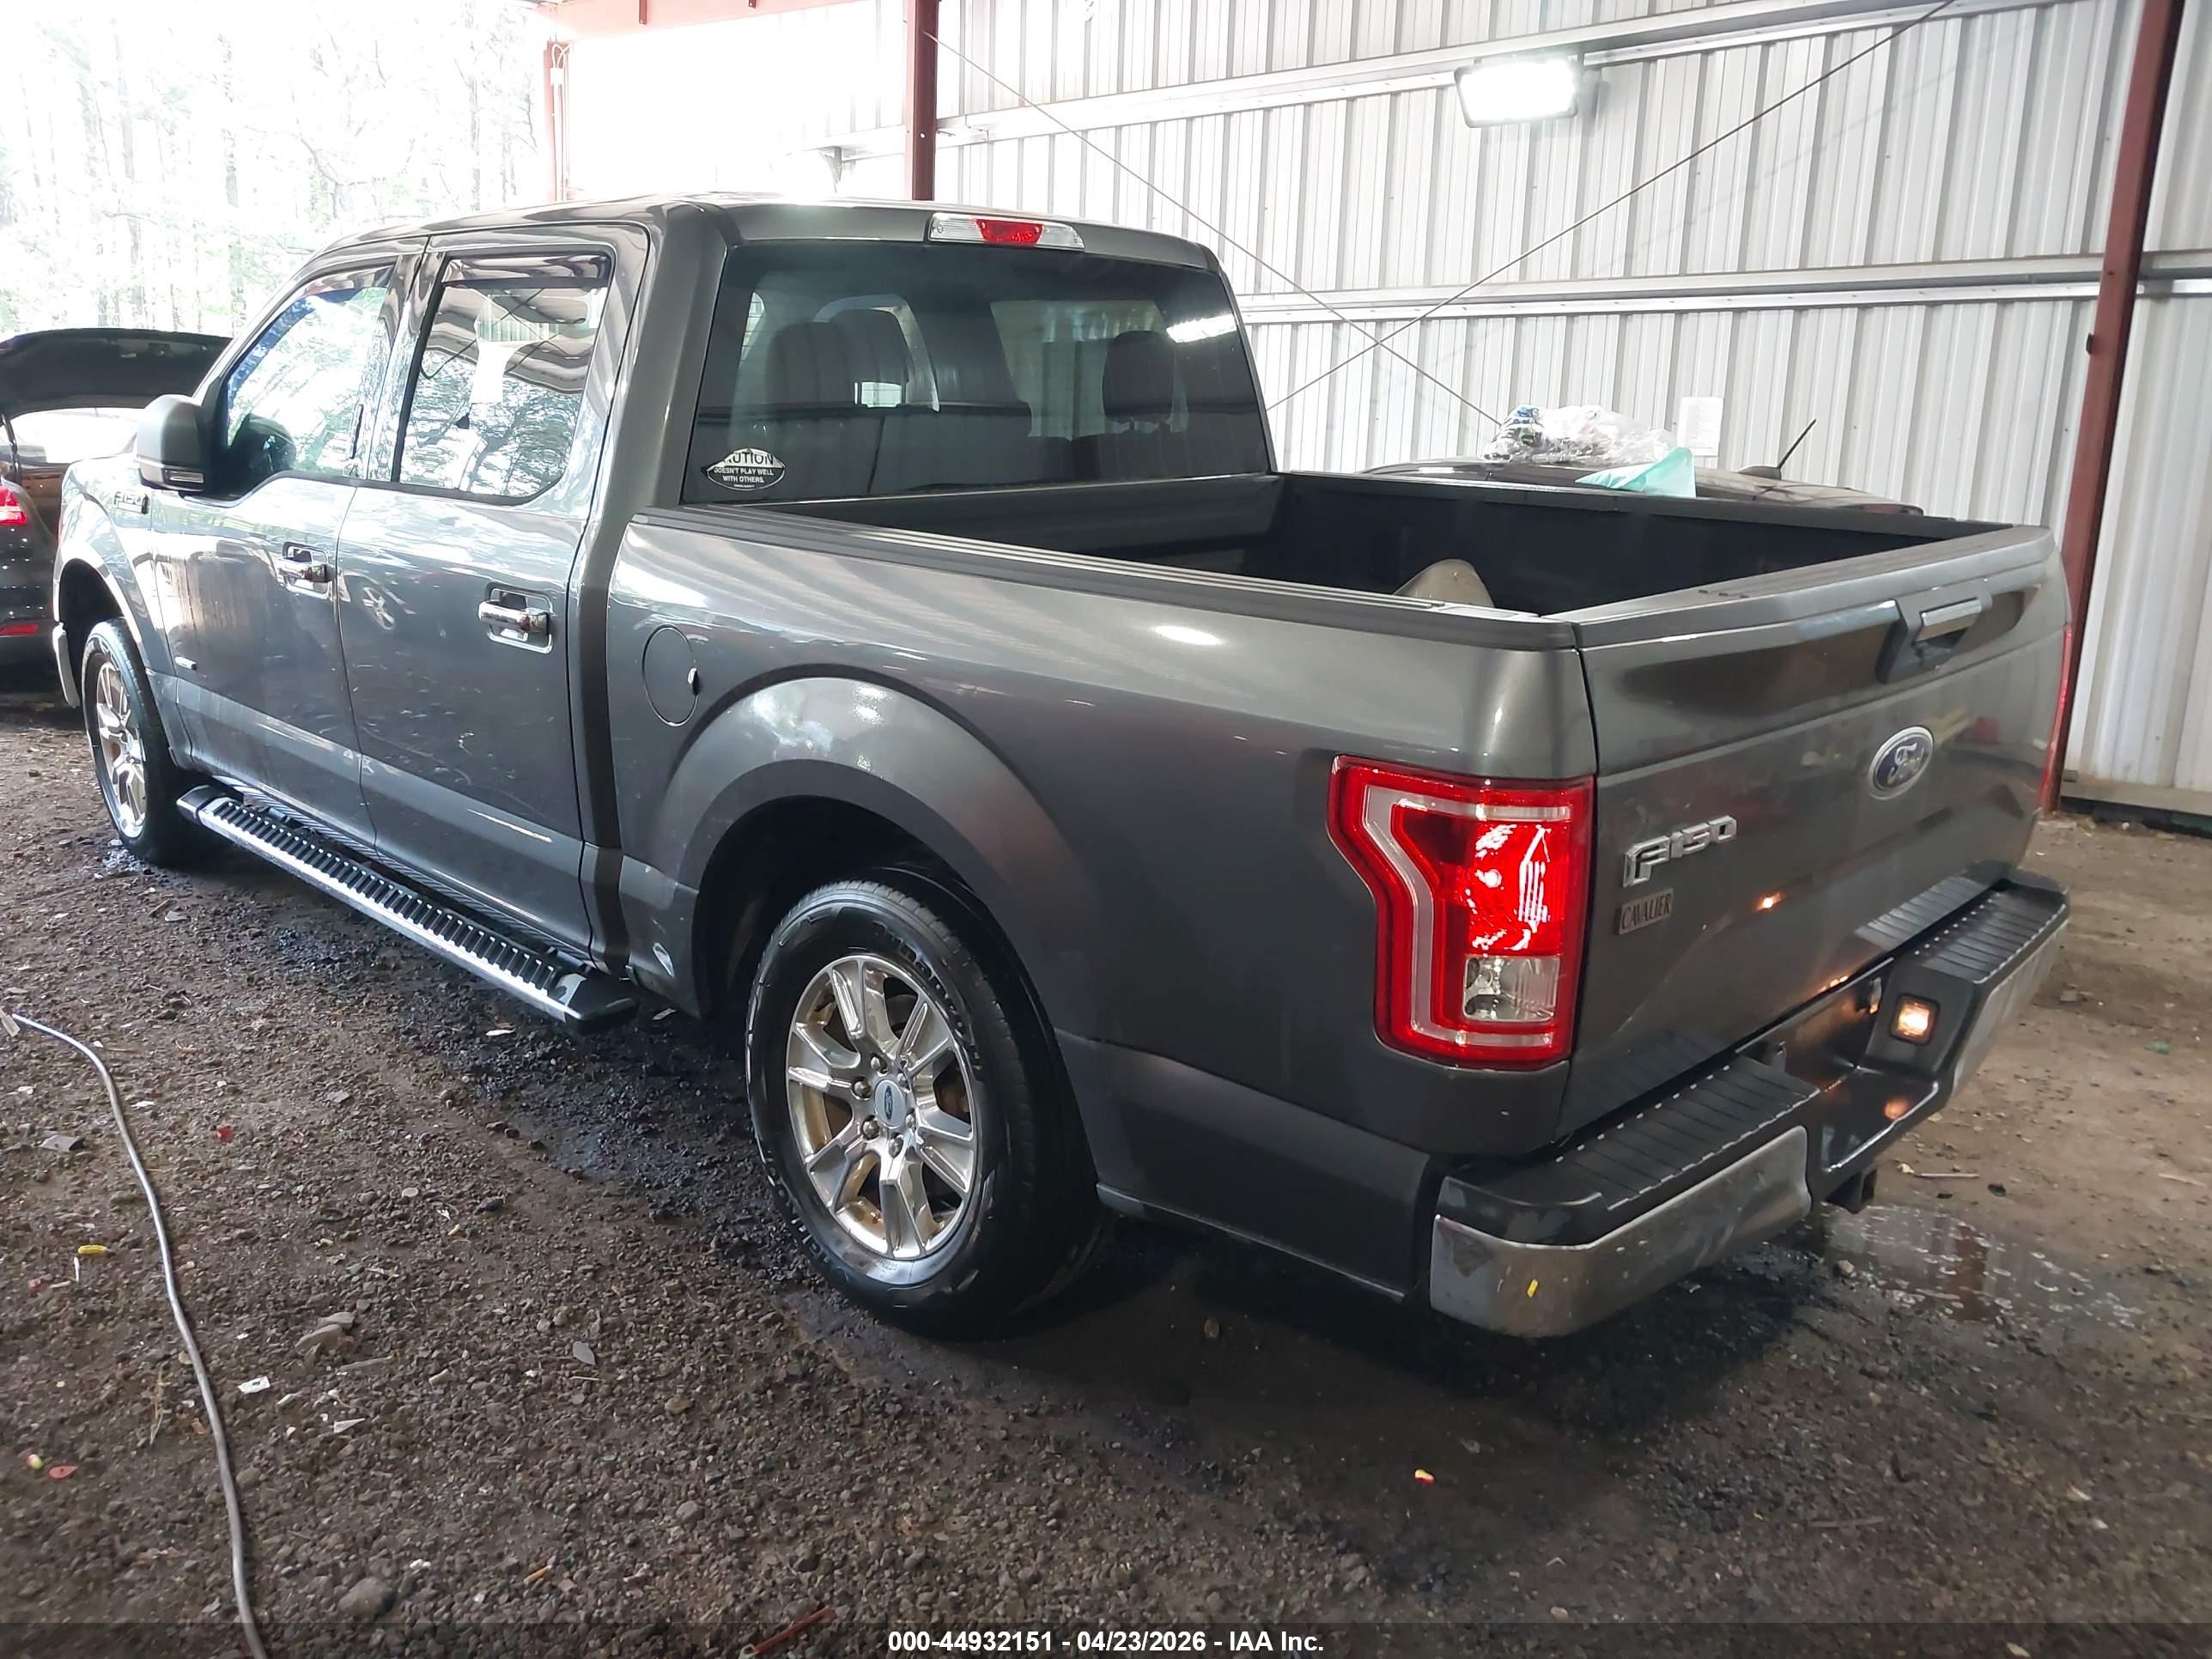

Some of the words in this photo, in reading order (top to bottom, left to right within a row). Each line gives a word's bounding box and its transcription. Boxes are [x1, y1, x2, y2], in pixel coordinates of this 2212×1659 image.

[714, 466, 739, 475] DOESN'T
[757, 468, 774, 477] WELL
[727, 452, 774, 465] UTION
[1887, 742, 1924, 785] Ford
[1621, 815, 1738, 889] F150
[1621, 892, 1672, 930] CAVALIER
